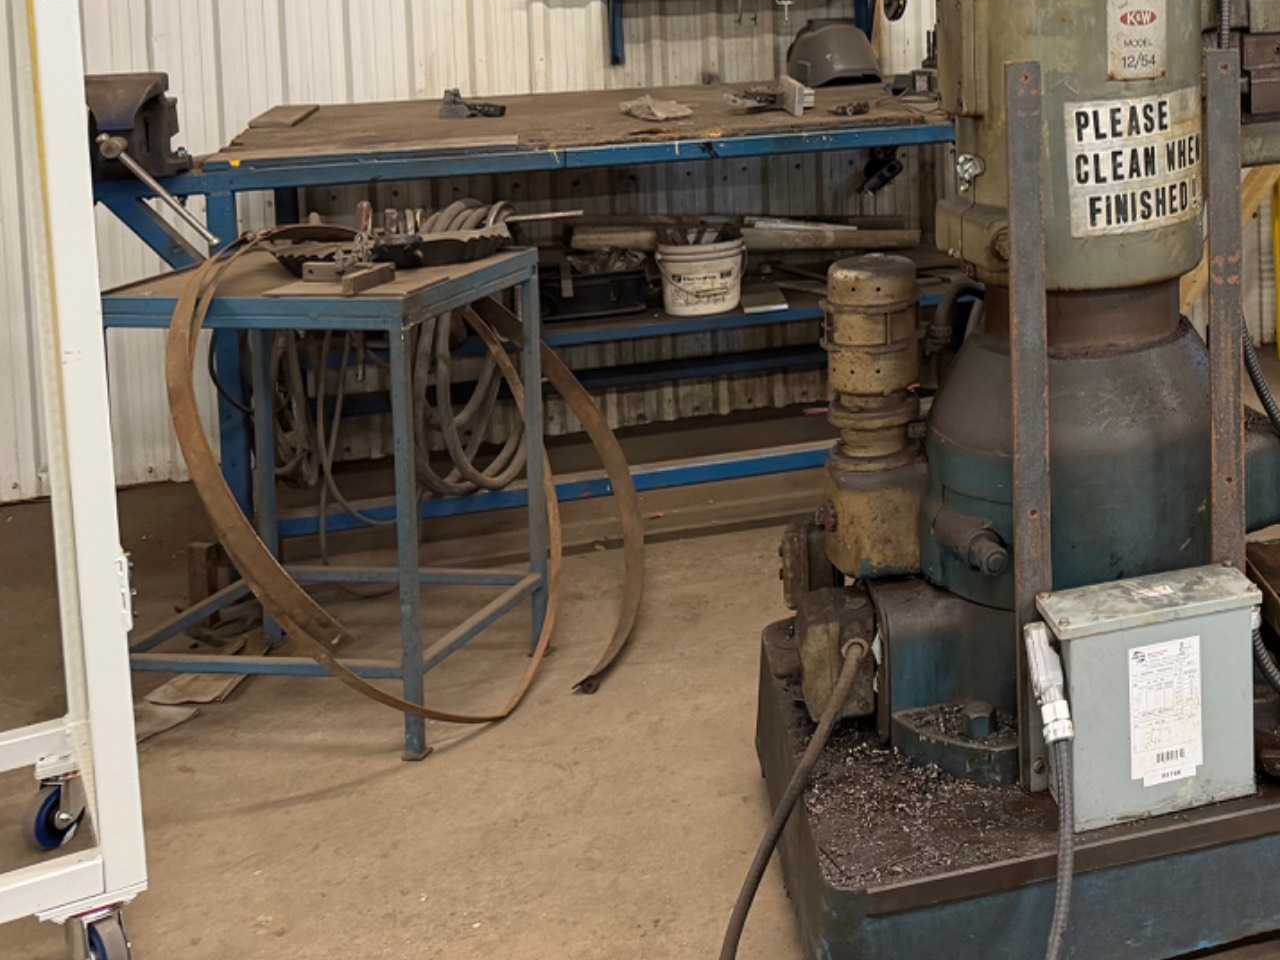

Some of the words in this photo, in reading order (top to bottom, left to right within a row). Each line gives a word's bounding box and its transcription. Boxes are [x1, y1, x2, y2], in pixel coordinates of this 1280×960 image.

[1121, 53, 1156, 69] 12/54
[1075, 100, 1168, 142] PLEASE
[1075, 145, 1156, 184] CLEAN
